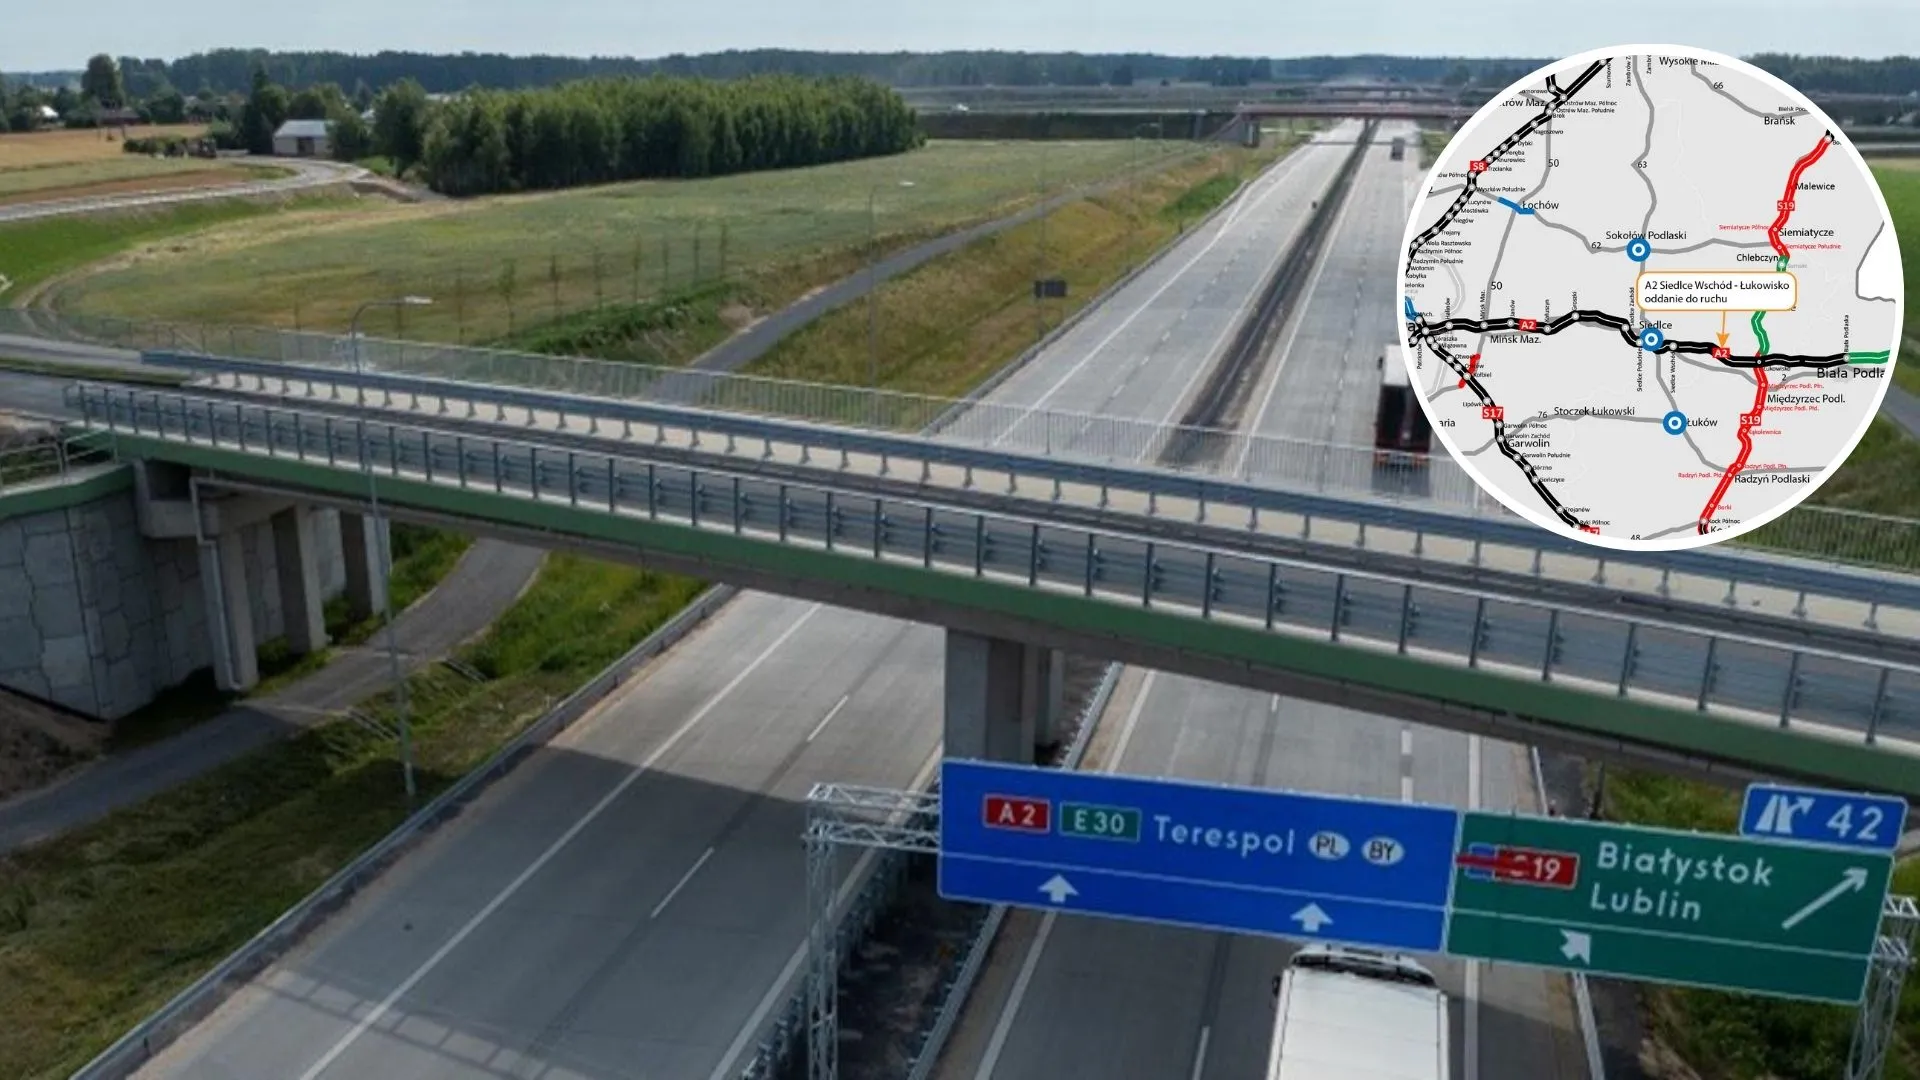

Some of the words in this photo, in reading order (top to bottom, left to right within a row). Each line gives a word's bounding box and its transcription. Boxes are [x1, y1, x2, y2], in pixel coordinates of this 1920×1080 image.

[1154, 815, 1295, 858] Terespol
[1316, 835, 1339, 856] PL
[1370, 840, 1396, 862] BY
[1826, 803, 1884, 840] 42
[1596, 841, 1774, 887] Białystok
[1590, 882, 1701, 921] Lublin
